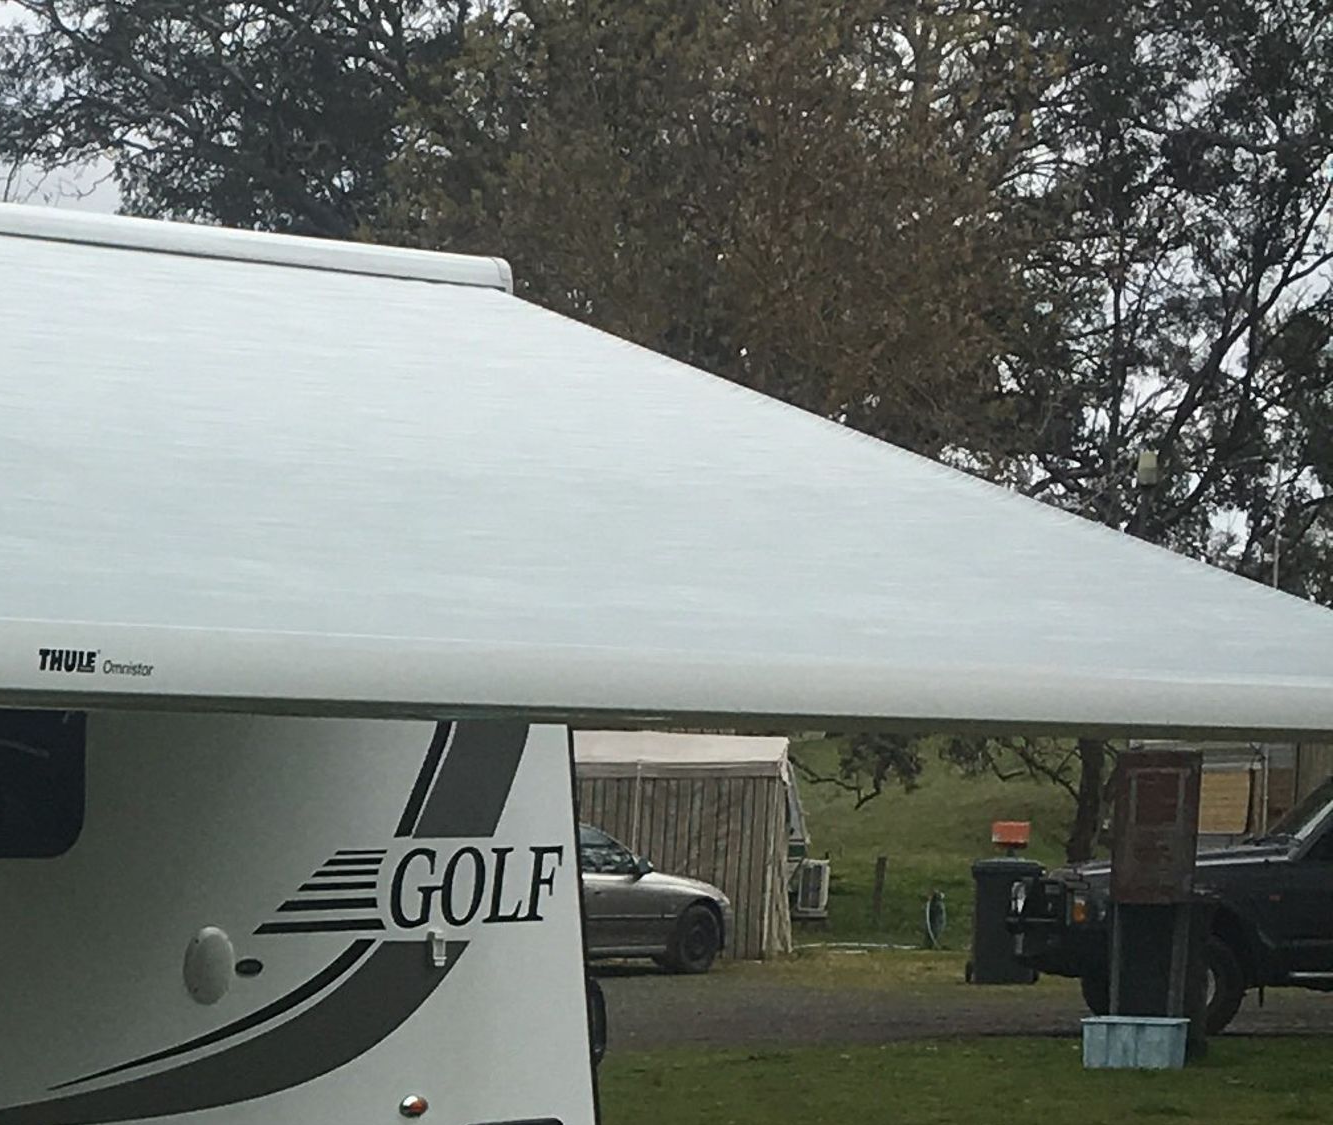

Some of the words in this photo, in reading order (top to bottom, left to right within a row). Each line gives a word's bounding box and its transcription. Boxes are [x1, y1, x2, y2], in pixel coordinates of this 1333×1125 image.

[39, 649, 97, 673] THULE
[102, 659, 154, 677] Omnistor
[390, 845, 564, 929] GOLF
